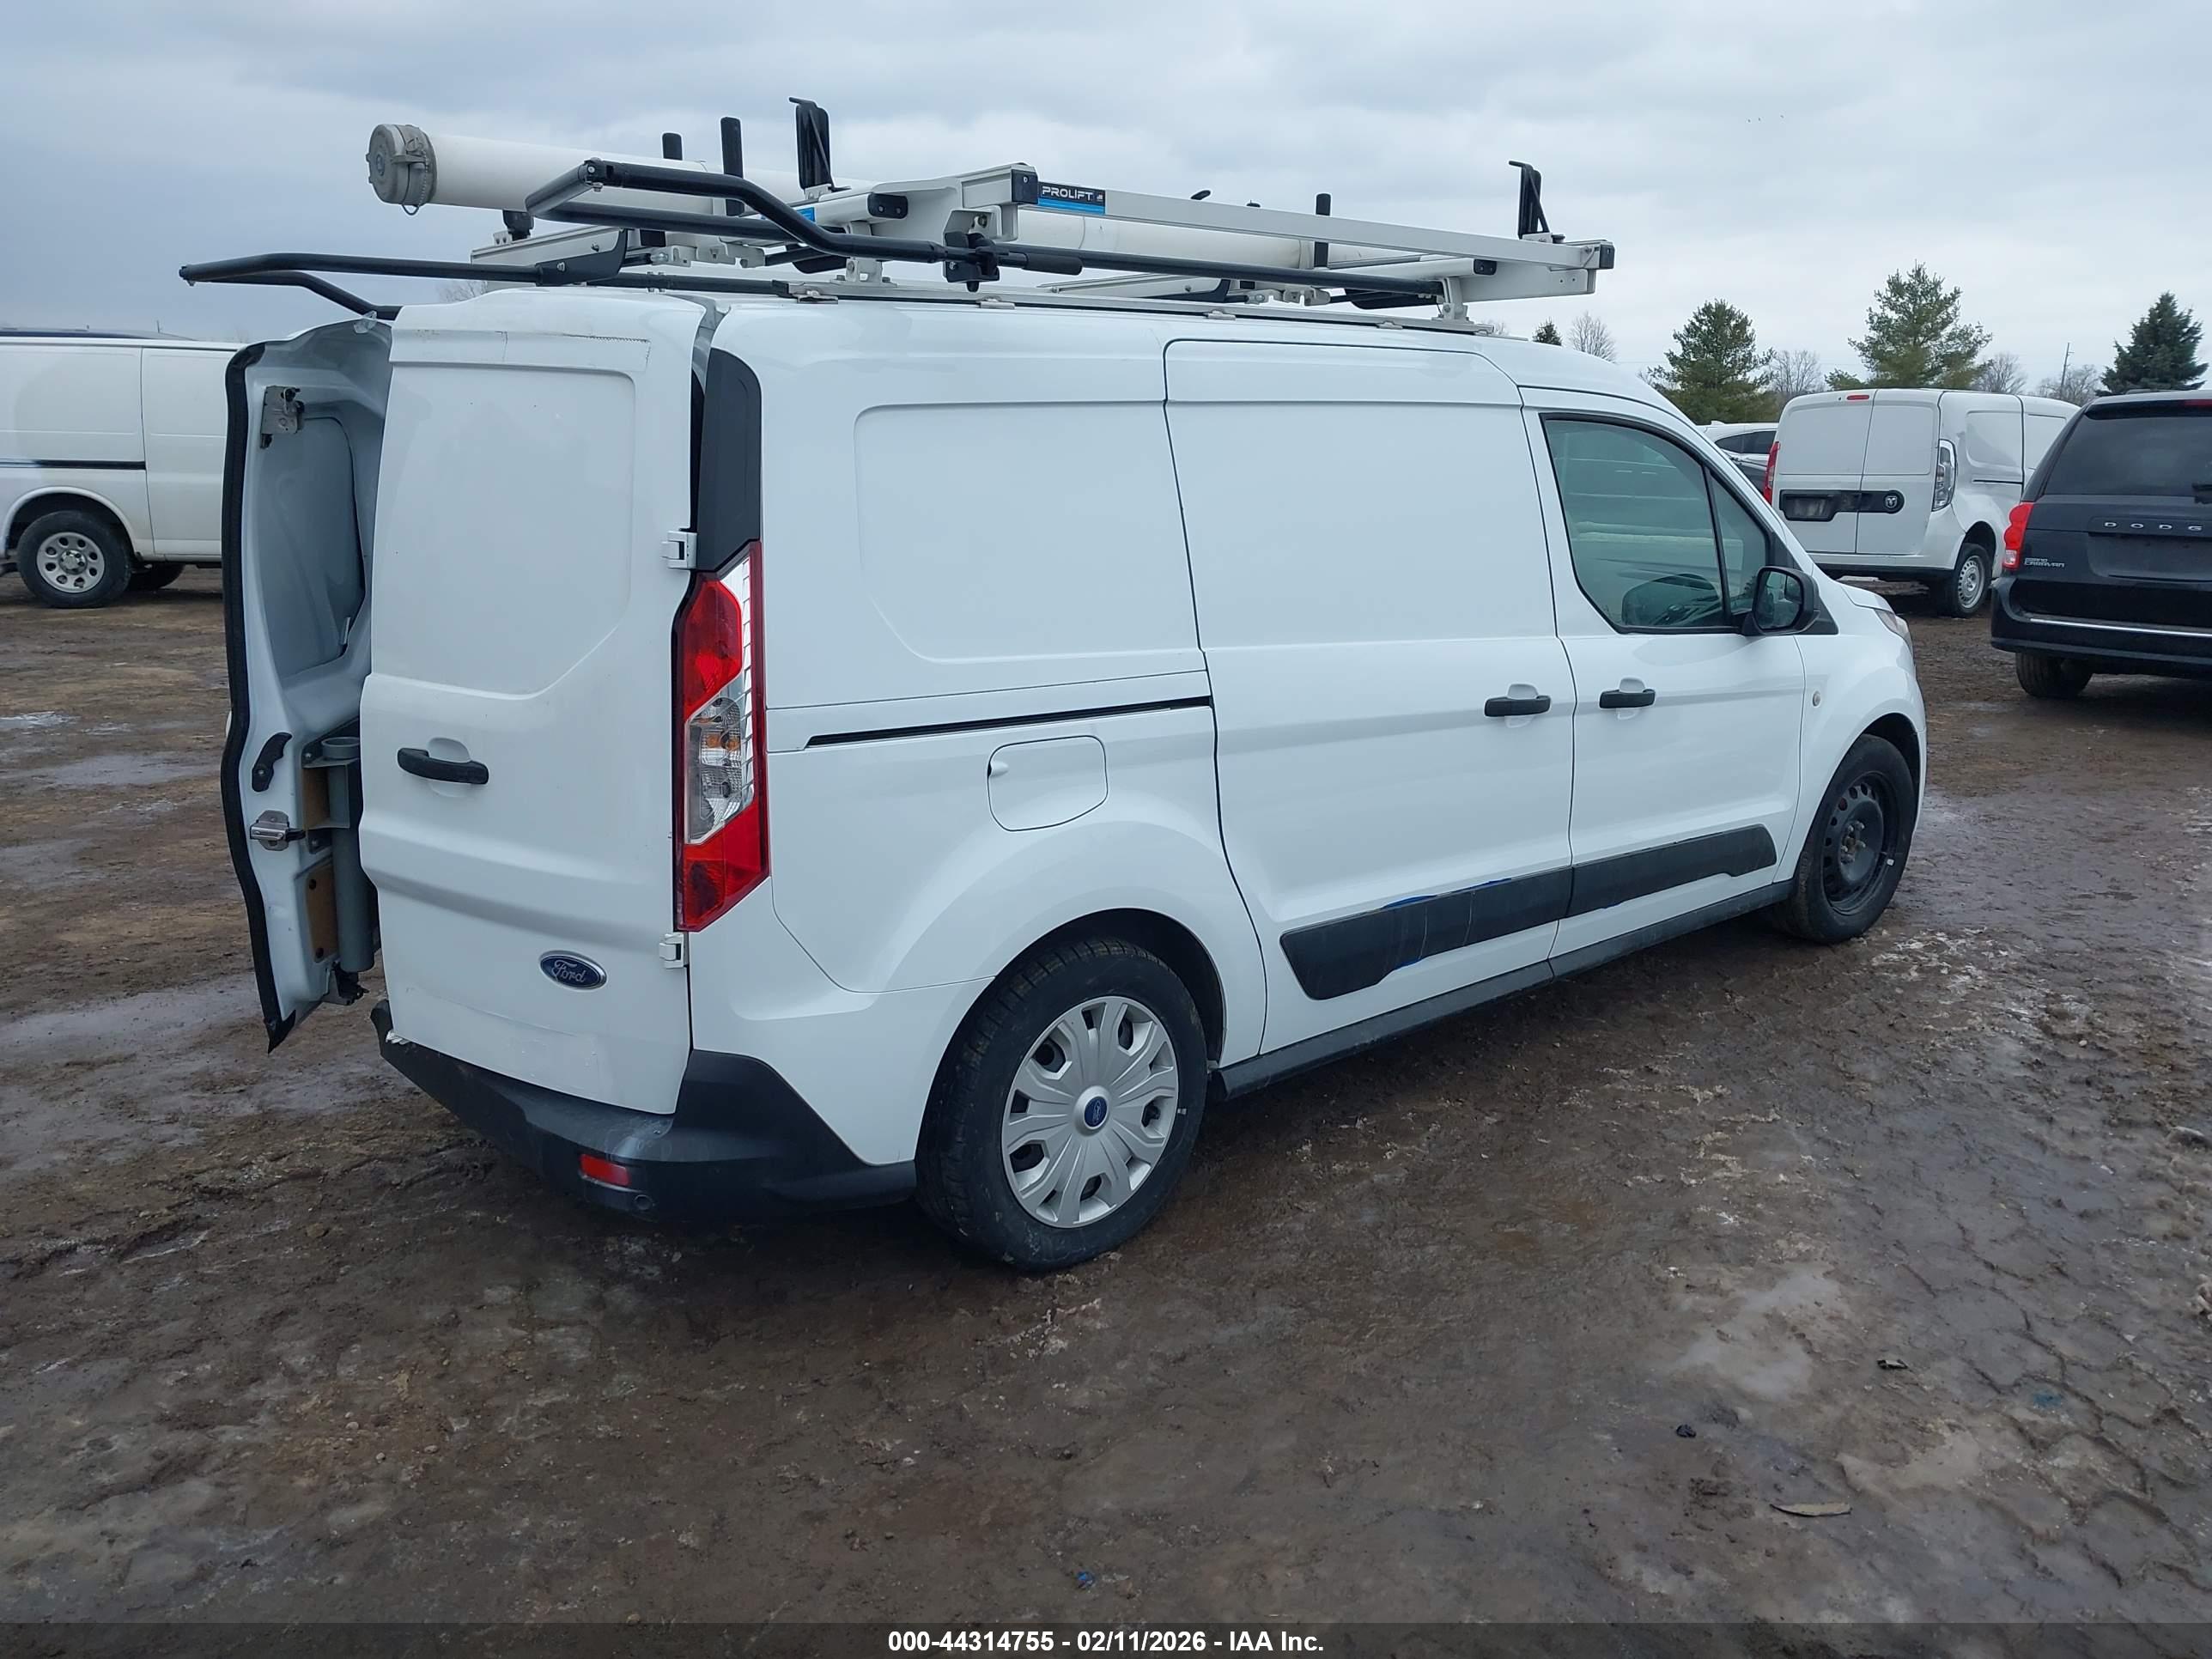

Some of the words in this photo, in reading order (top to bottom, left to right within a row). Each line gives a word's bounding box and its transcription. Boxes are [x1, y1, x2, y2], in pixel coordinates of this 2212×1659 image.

[1042, 185, 1094, 201] PROLIFT
[2104, 521, 2203, 532] DODG
[551, 959, 586, 983] Ford
